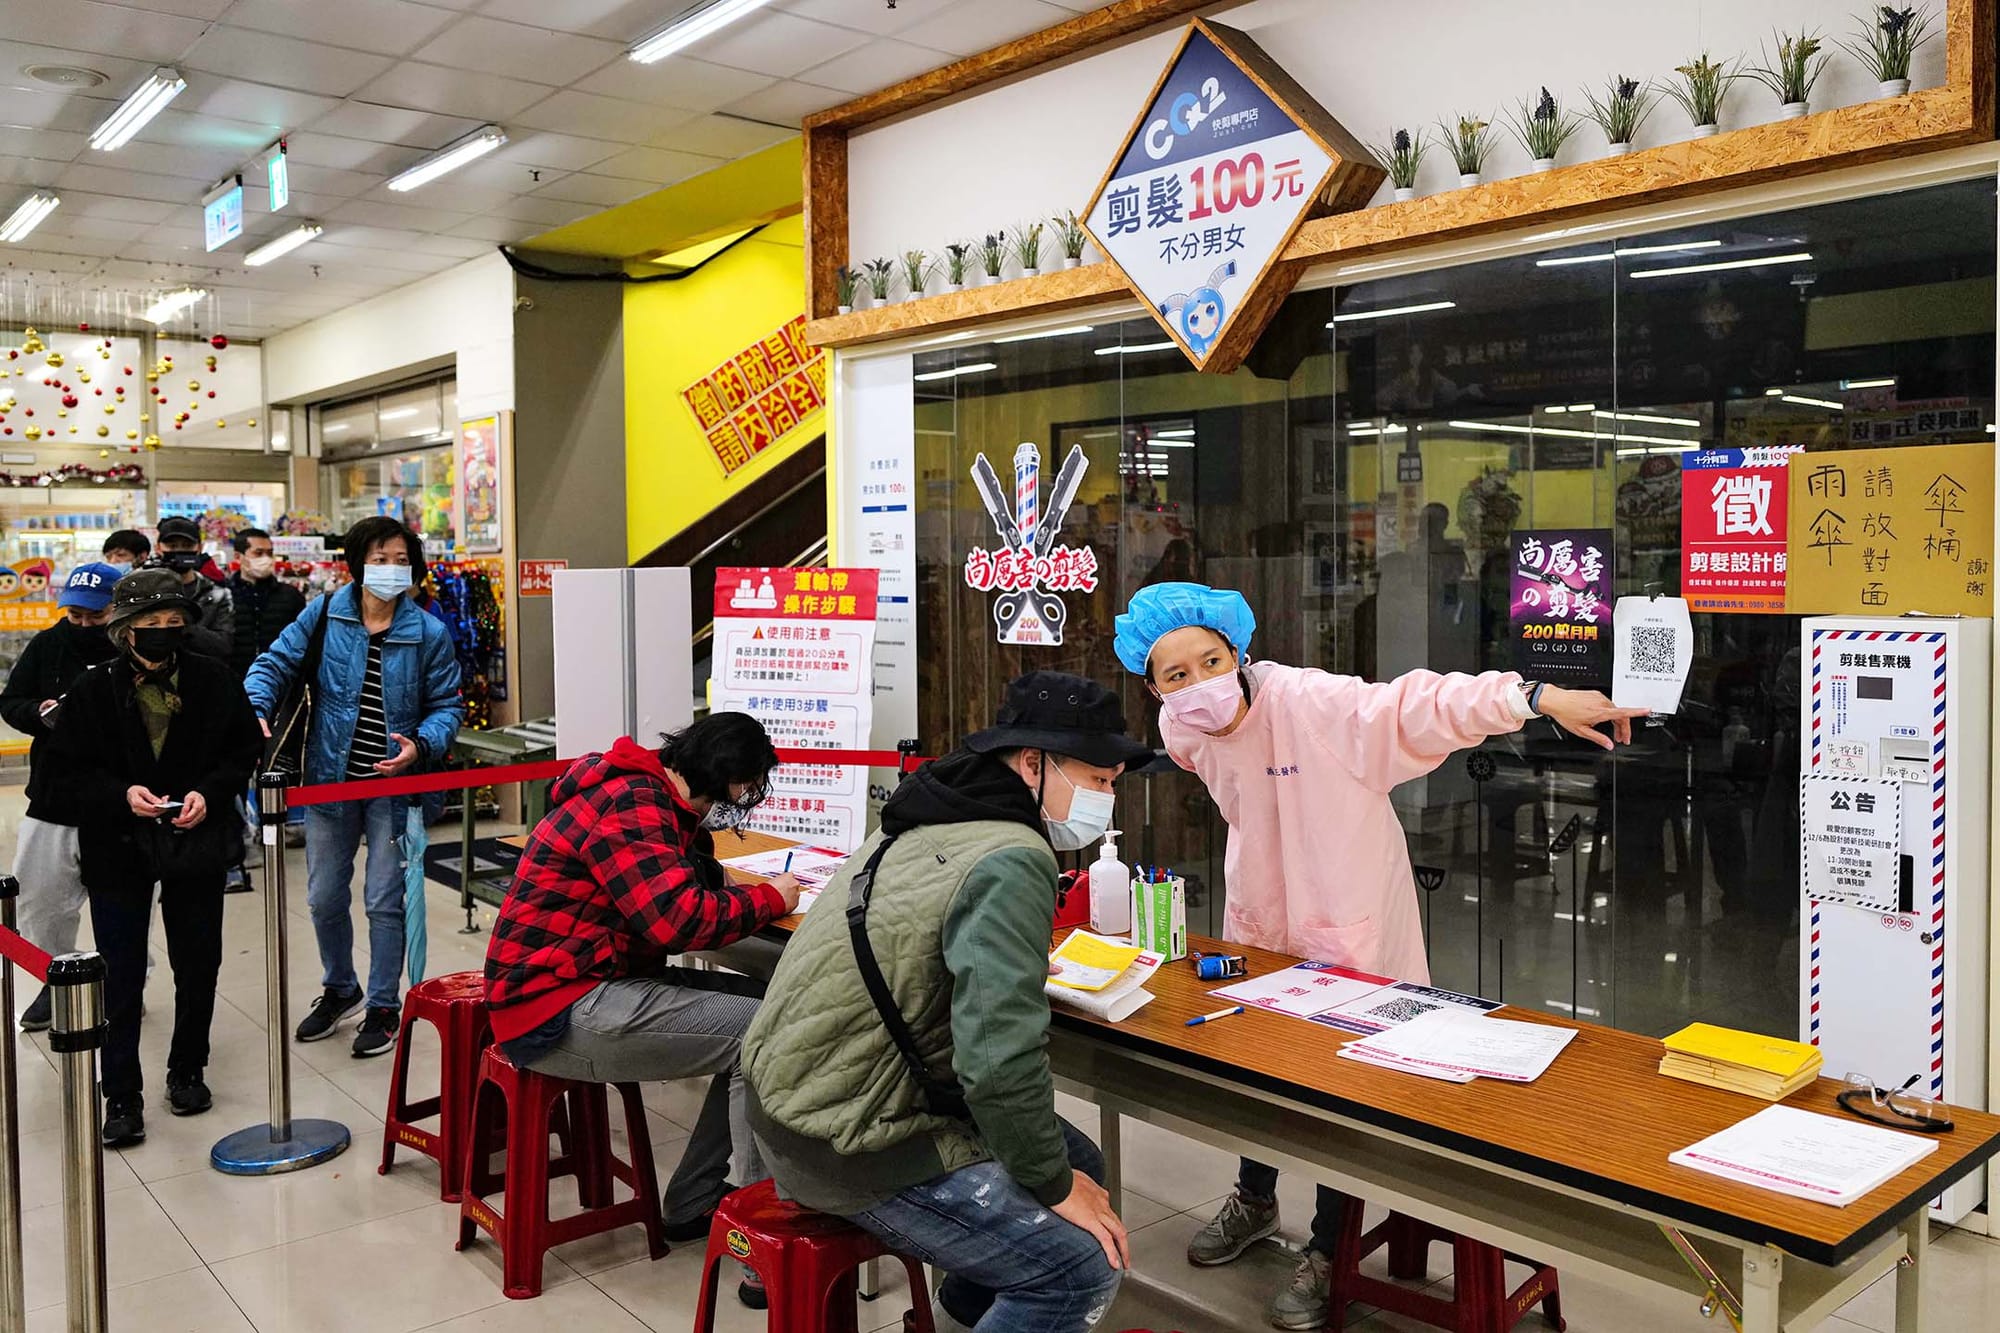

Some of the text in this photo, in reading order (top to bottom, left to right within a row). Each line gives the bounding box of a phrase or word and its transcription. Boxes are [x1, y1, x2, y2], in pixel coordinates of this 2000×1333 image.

[1212, 107, 1259, 132] 快剪專門店
[1159, 223, 1246, 264] 不分男女
[1711, 475, 1775, 536] 徵
[1807, 464, 1853, 566] 雨傘
[1923, 473, 1968, 563] 傘桶
[1861, 466, 1898, 606] 請放對面
[967, 548, 1096, 588] 尚厲害の剪髮
[1518, 536, 1604, 582] 尚厲害
[1690, 552, 1787, 574] 剪髮設計師
[70, 572, 102, 588] GAP
[794, 571, 849, 592] 運輸帶
[1967, 558, 1990, 597] 謝謝
[783, 594, 857, 615] 操作步驟
[1522, 581, 1600, 623] の剪髮
[767, 626, 831, 641] 使用前注意
[1019, 617, 1039, 629] 200
[1839, 653, 1912, 669] 剪髮售票機
[748, 697, 829, 712] 操作使用3步驟
[1830, 790, 1876, 814] 公告
